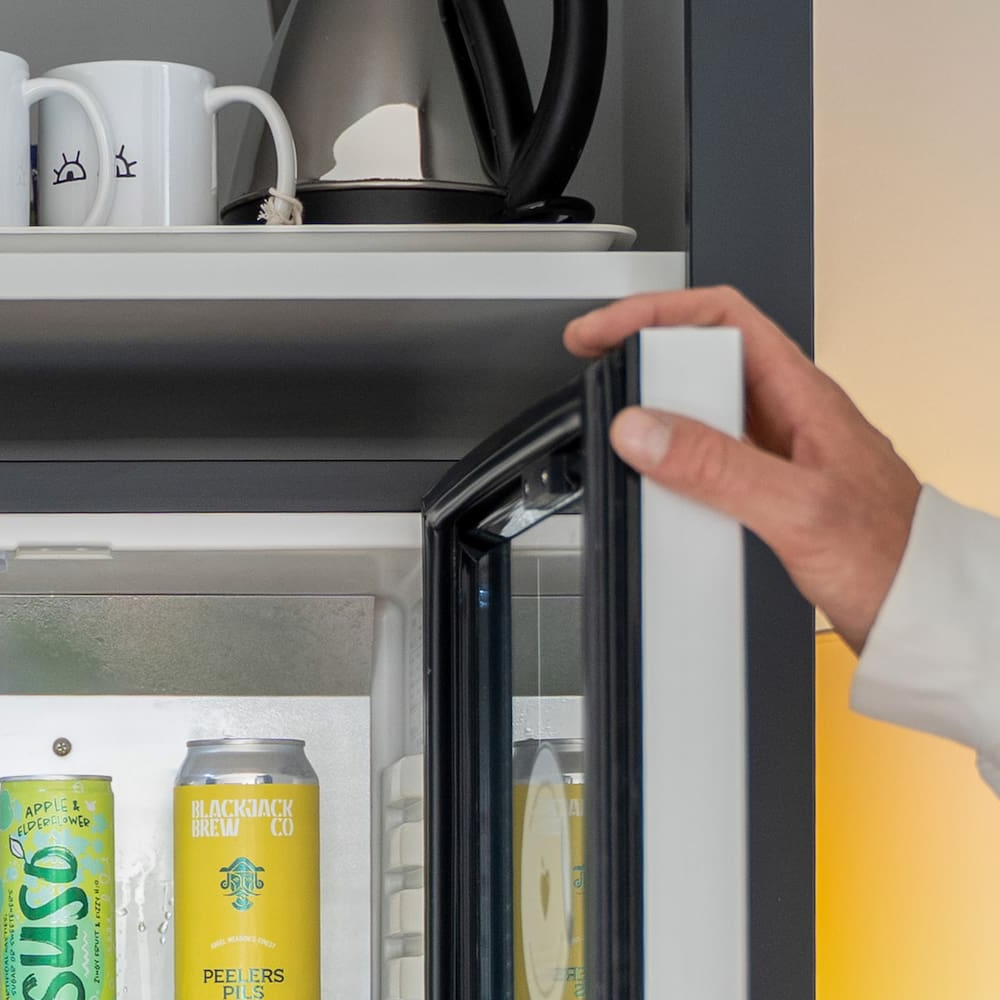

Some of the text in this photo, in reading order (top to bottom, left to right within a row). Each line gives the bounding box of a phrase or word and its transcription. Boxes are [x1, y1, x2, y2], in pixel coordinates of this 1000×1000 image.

[25, 798, 80, 818] APPLE &
[192, 799, 293, 818] BLACKJACK
[17, 815, 90, 837] ELDERFLOWER
[192, 818, 294, 838] BREW CO
[203, 968, 285, 984] PEELERS
[223, 985, 265, 1000] PILS
